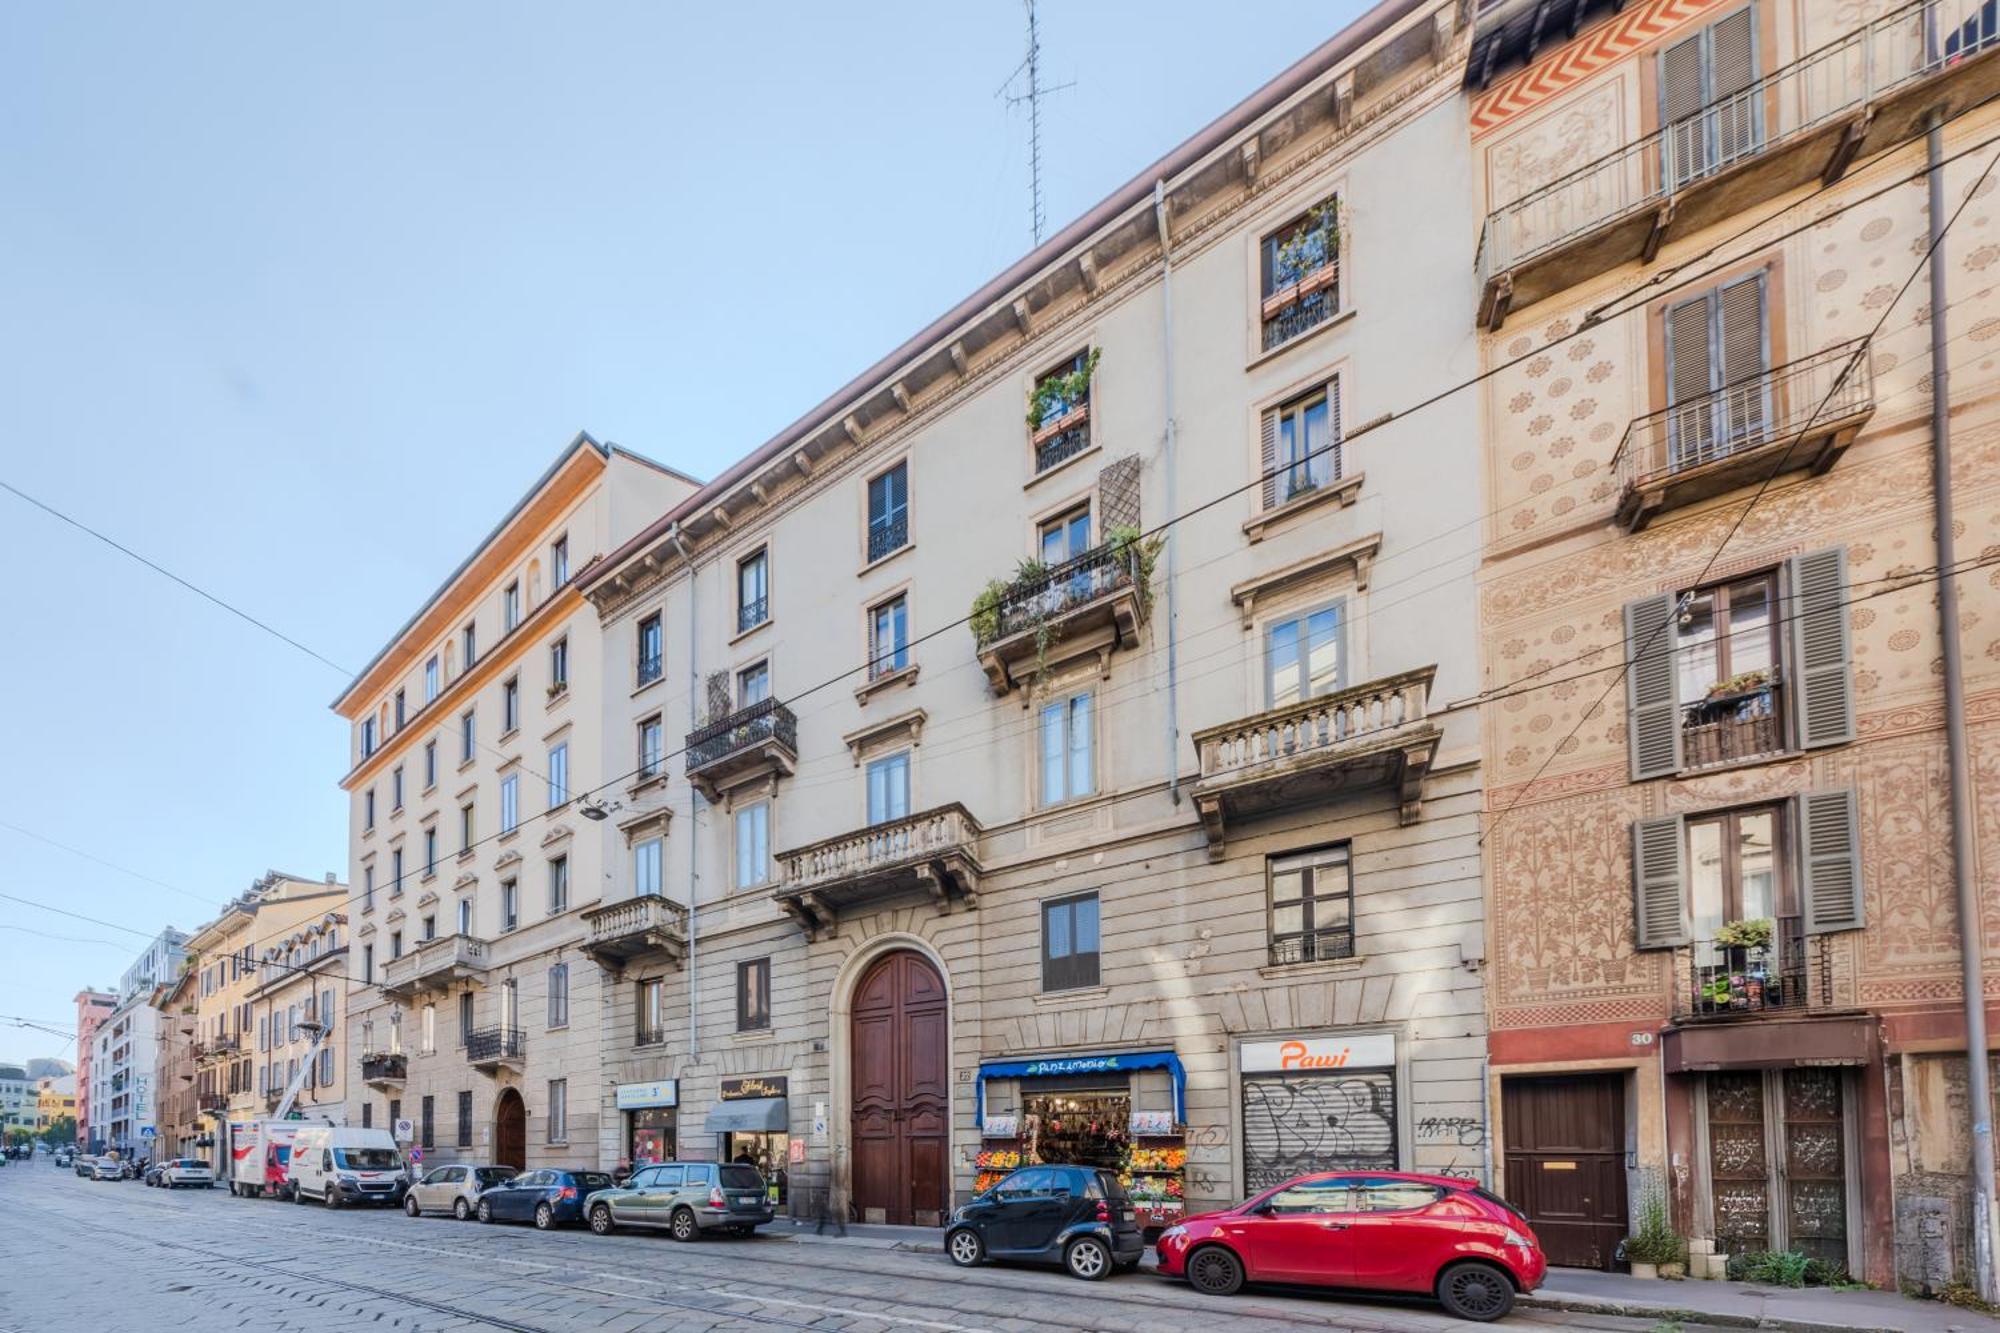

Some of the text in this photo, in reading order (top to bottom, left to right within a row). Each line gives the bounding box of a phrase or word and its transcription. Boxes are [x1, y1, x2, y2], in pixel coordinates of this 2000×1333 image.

[1631, 1032, 1652, 1046] 30
[1279, 1040, 1350, 1069] Pawi
[136, 1077, 148, 1120] HOTEL
